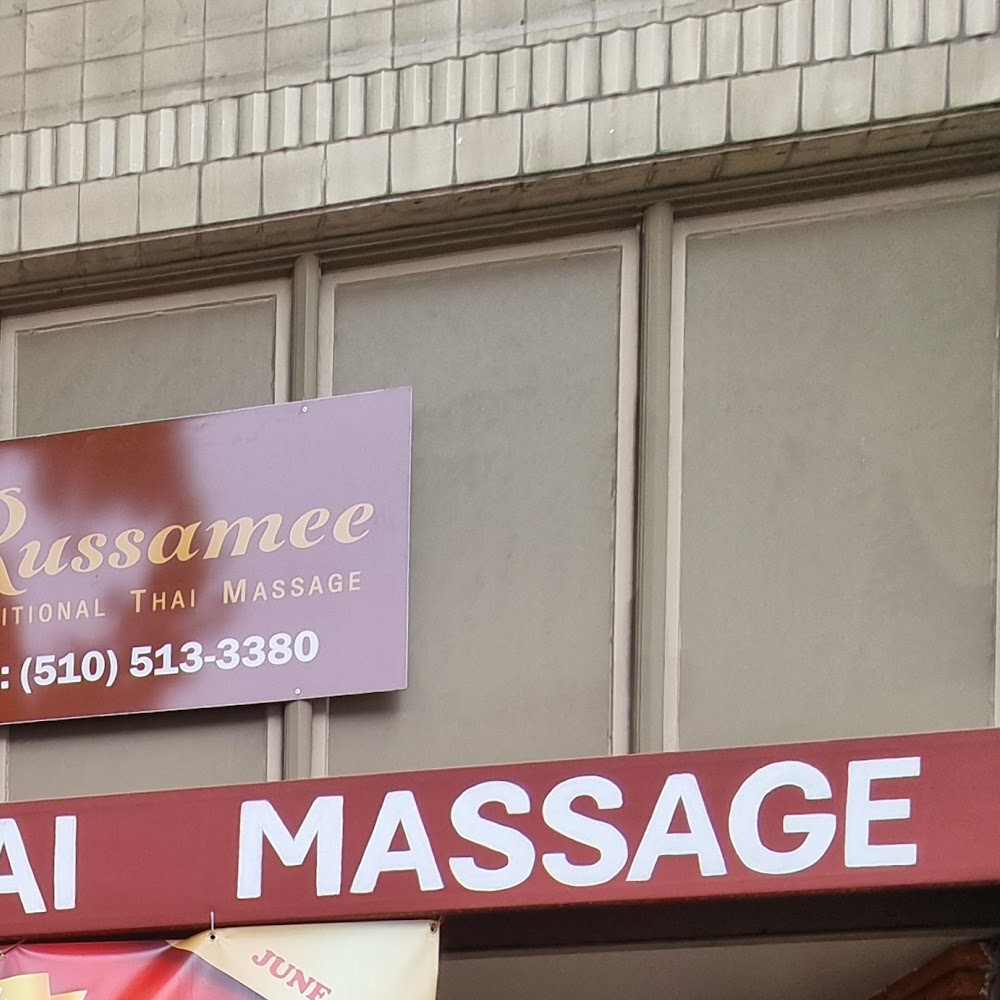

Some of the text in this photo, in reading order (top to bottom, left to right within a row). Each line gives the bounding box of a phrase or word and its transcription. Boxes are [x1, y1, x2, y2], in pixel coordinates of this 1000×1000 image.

[130, 588, 197, 615] THAI
[223, 570, 363, 603] MASSAGE
[20, 648, 118, 694] (510)
[129, 630, 320, 679] 513-3380
[237, 756, 922, 900] MASSAGE
